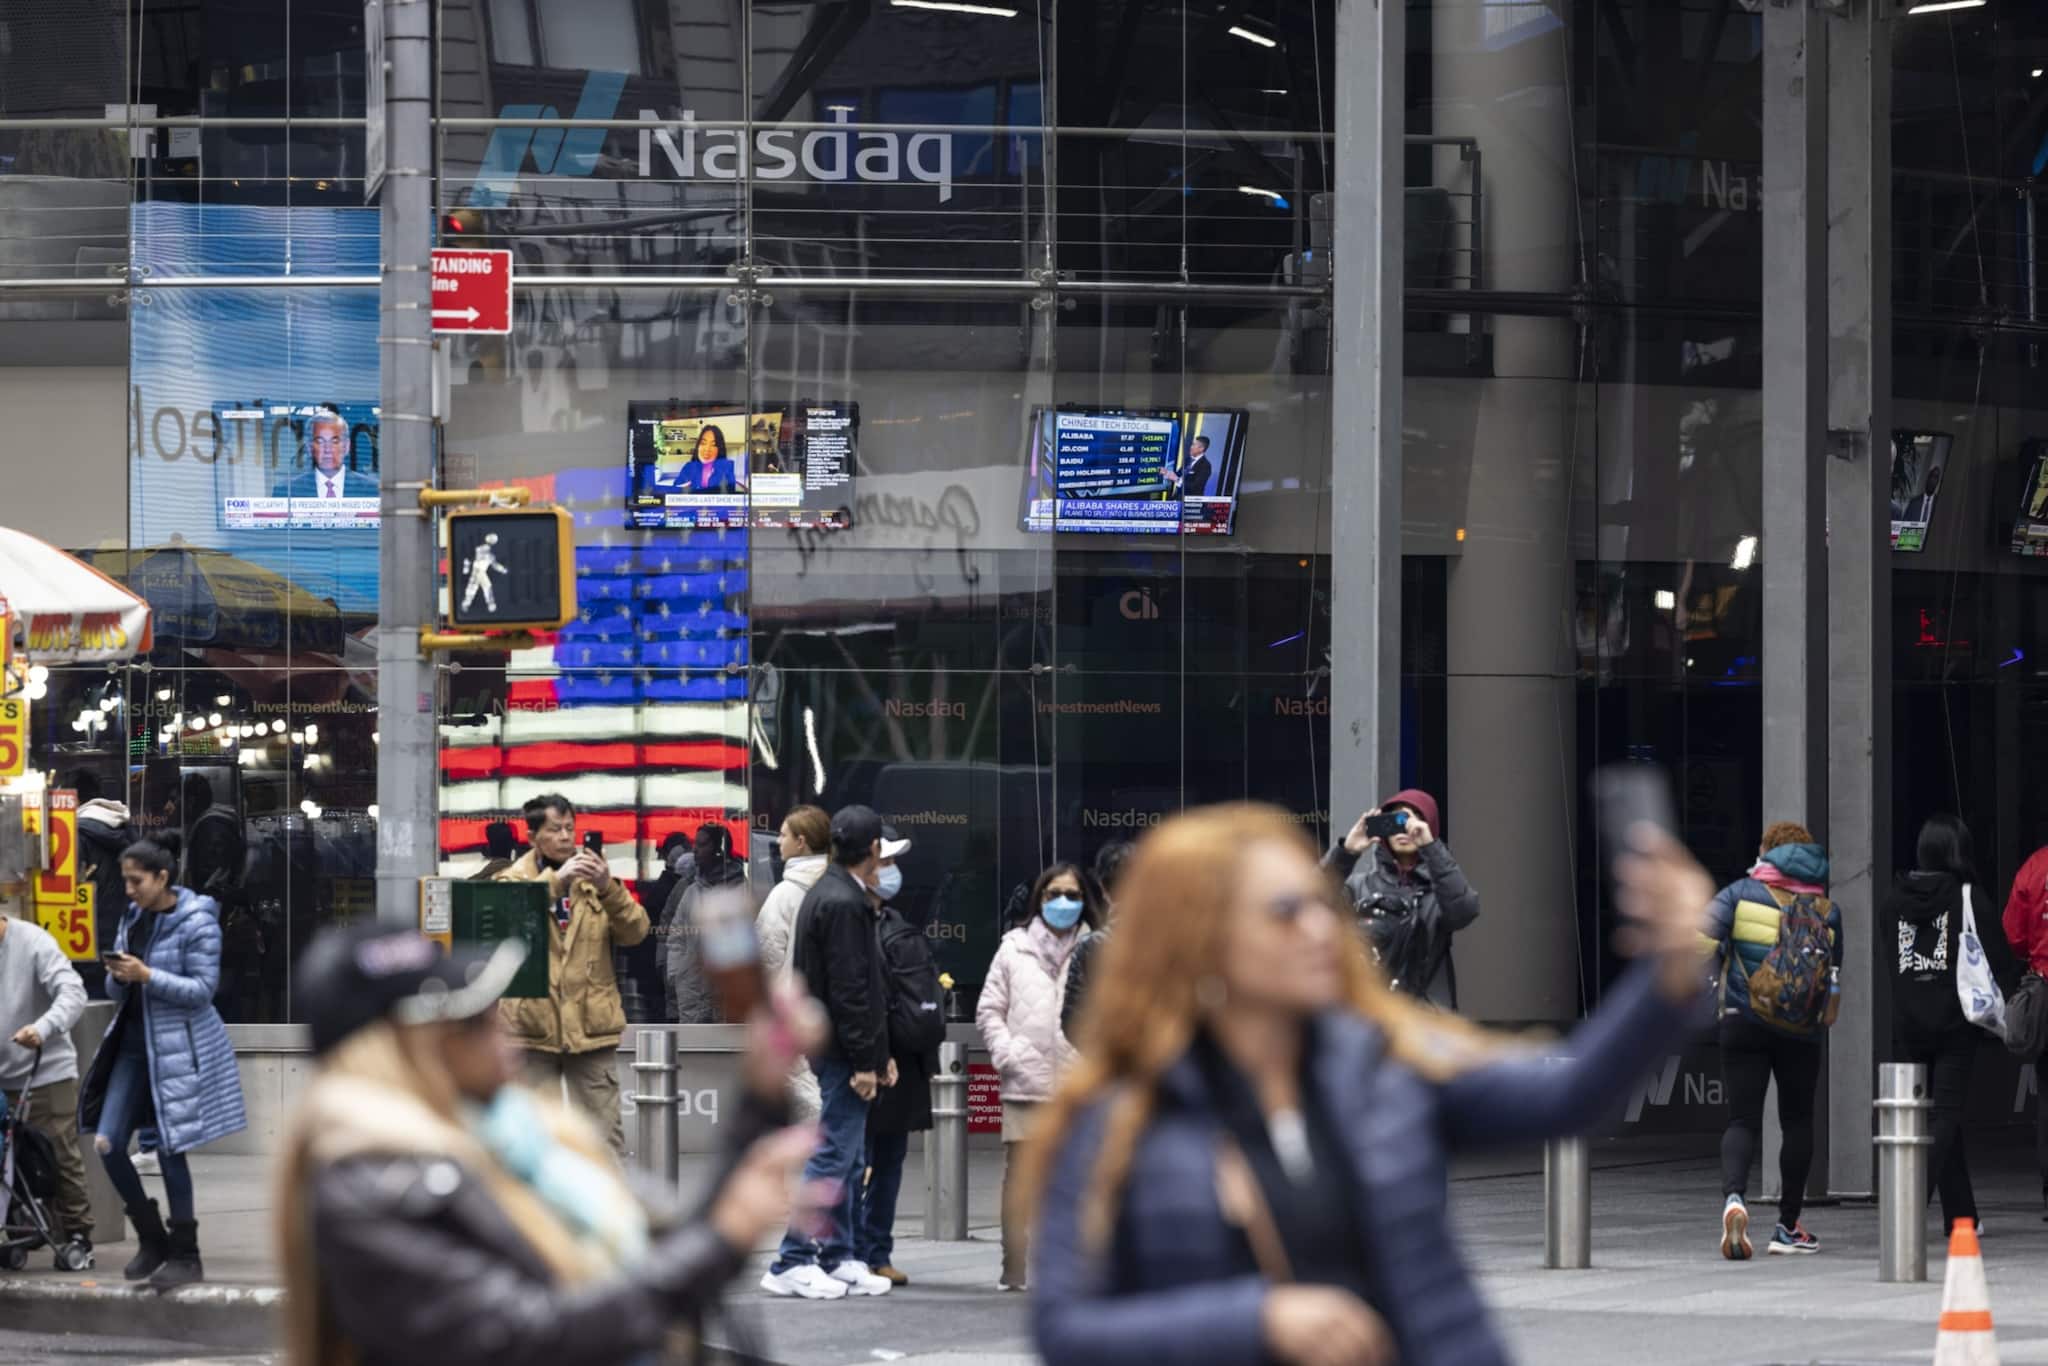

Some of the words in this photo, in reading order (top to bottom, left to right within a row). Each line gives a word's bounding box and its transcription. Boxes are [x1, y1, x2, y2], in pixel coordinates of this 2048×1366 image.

[638, 109, 952, 203] Nasdaq
[431, 257, 492, 274] TANDING
[431, 275, 459, 292] ime
[1061, 418, 1099, 427] CHINESE
[1101, 420, 1120, 429] TECH
[1060, 432, 1094, 440] ALIBABA
[1066, 502, 1103, 510] ALIBABA
[1105, 502, 1139, 511] SHARES
[1141, 503, 1178, 511] JUMPING
[885, 699, 966, 720] Nasdaq
[1037, 700, 1161, 714] InvestmentNews
[1274, 696, 1329, 716] Nasd
[52, 794, 76, 809] UTS
[40, 815, 73, 893] 2
[77, 887, 88, 904] S
[967, 1094, 987, 1102] ATED
[988, 1116, 1002, 1124] STR
